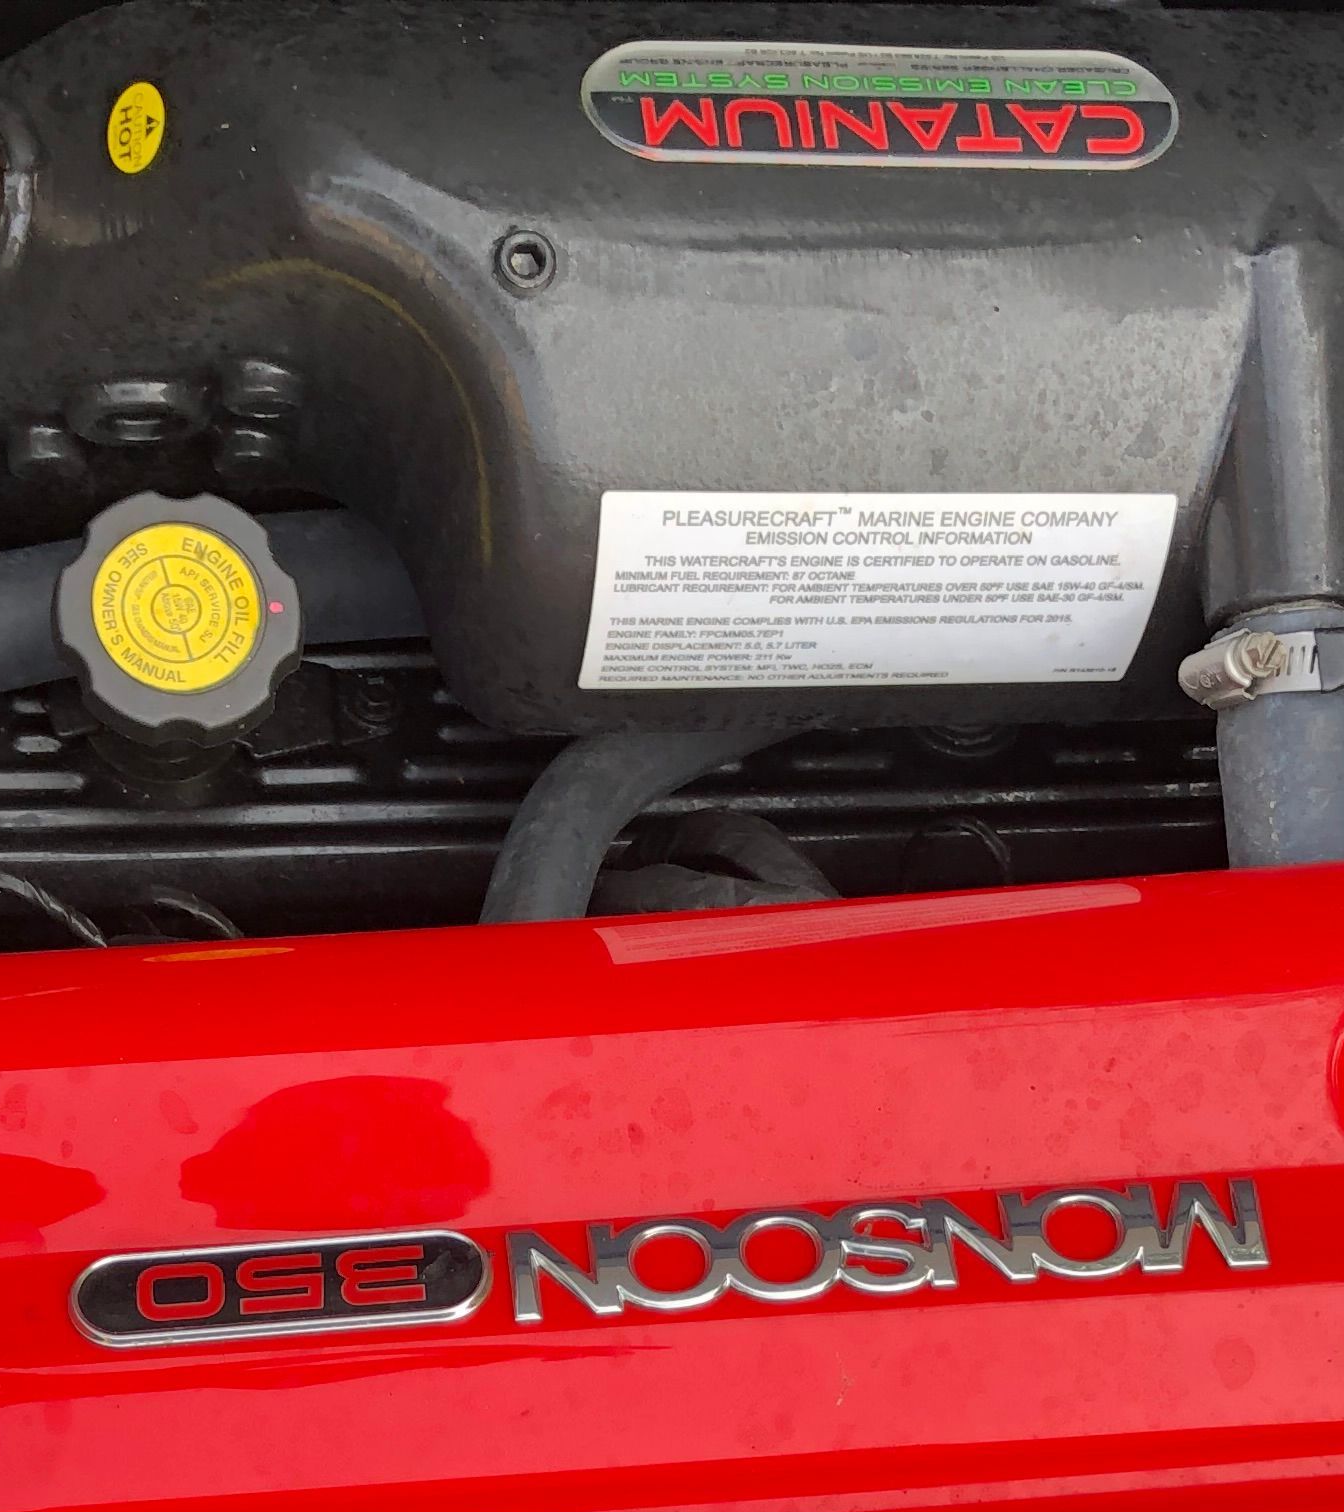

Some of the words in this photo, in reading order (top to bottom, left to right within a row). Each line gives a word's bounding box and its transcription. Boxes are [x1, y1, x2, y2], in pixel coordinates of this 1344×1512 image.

[618, 70, 787, 92] SYSTEM
[802, 73, 988, 94] EMISSION
[1003, 77, 1138, 96] CLEAN
[118, 105, 133, 161] HOT
[133, 93, 144, 168] CAUTION
[639, 96, 1145, 154] CATANIUM
[856, 511, 935, 527] MARINE
[938, 511, 1016, 527] ENGINE
[1019, 511, 1118, 527] COMPANY
[745, 532, 829, 545] EMISSION
[831, 532, 915, 545] CONTROL
[917, 532, 1032, 545] INFORMATION
[120, 543, 149, 569] SEE
[182, 537, 244, 591] ENGINE
[644, 556, 677, 567] THIS
[678, 555, 787, 567] WATERCRAFT'S
[789, 555, 844, 567] ENGINE
[845, 555, 860, 567] IS
[862, 555, 935, 567] CERTIFIED
[936, 555, 957, 567] TO
[959, 555, 1024, 567] OPERATE
[1025, 555, 1047, 566] ON
[614, 583, 680, 593] LUBRICANT
[770, 583, 796, 592] FOR
[797, 583, 849, 592] AMBIENT
[850, 582, 943, 592] TEMPERATURES
[944, 582, 978, 592] OVER
[1005, 582, 1029, 592] USE
[1030, 582, 1055, 592] SAE
[615, 571, 668, 581] MINIMUM
[669, 571, 701, 581] FUEL
[806, 571, 855, 581] OCTANE
[102, 570, 124, 647] OWNER'S
[179, 566, 199, 582] API
[199, 577, 221, 630] SERVICE
[233, 596, 250, 627] OIL
[769, 595, 794, 605] FOR
[795, 595, 847, 604] AMBIENT
[847, 594, 940, 604] TEMPERATURES
[941, 594, 983, 603] UNDER
[1010, 594, 1034, 603] USE
[213, 633, 246, 665] FILL
[120, 646, 187, 684] MANUAL
[508, 1177, 1270, 1322] MONSOON
[134, 1243, 428, 1323] 350
